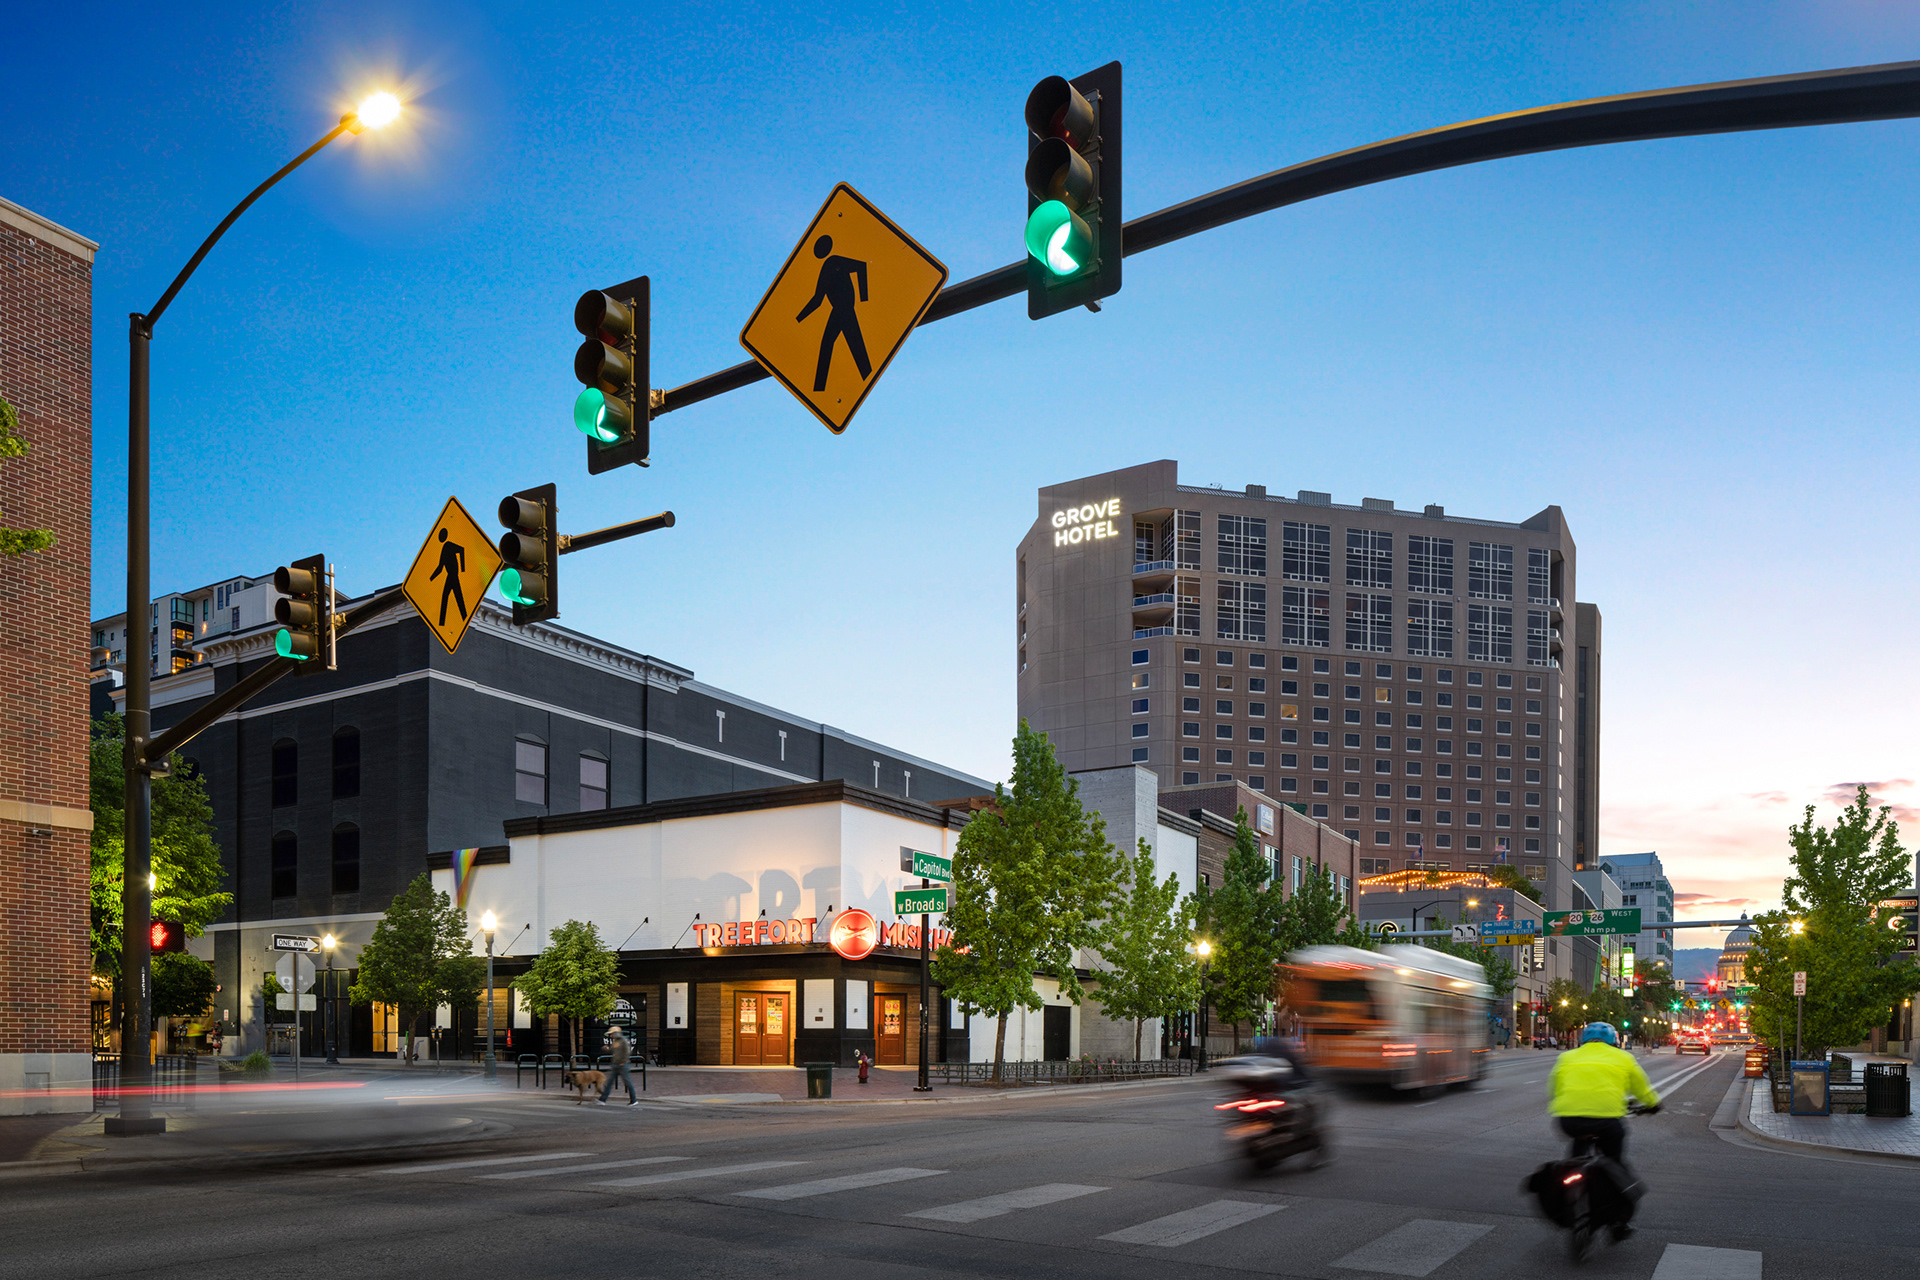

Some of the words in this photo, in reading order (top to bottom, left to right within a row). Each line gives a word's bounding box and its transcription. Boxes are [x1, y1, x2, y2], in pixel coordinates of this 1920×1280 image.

[1051, 498, 1121, 529] GROVE
[1055, 520, 1119, 547] HOTEL
[914, 862, 918, 872] N
[919, 859, 942, 877] Capitol
[942, 867, 950, 878] Blvd
[898, 903, 904, 912] W
[905, 897, 934, 912] Broad
[1570, 914, 1582, 922] 20
[1591, 913, 1604, 922] 26
[692, 917, 818, 947] TREEFORT
